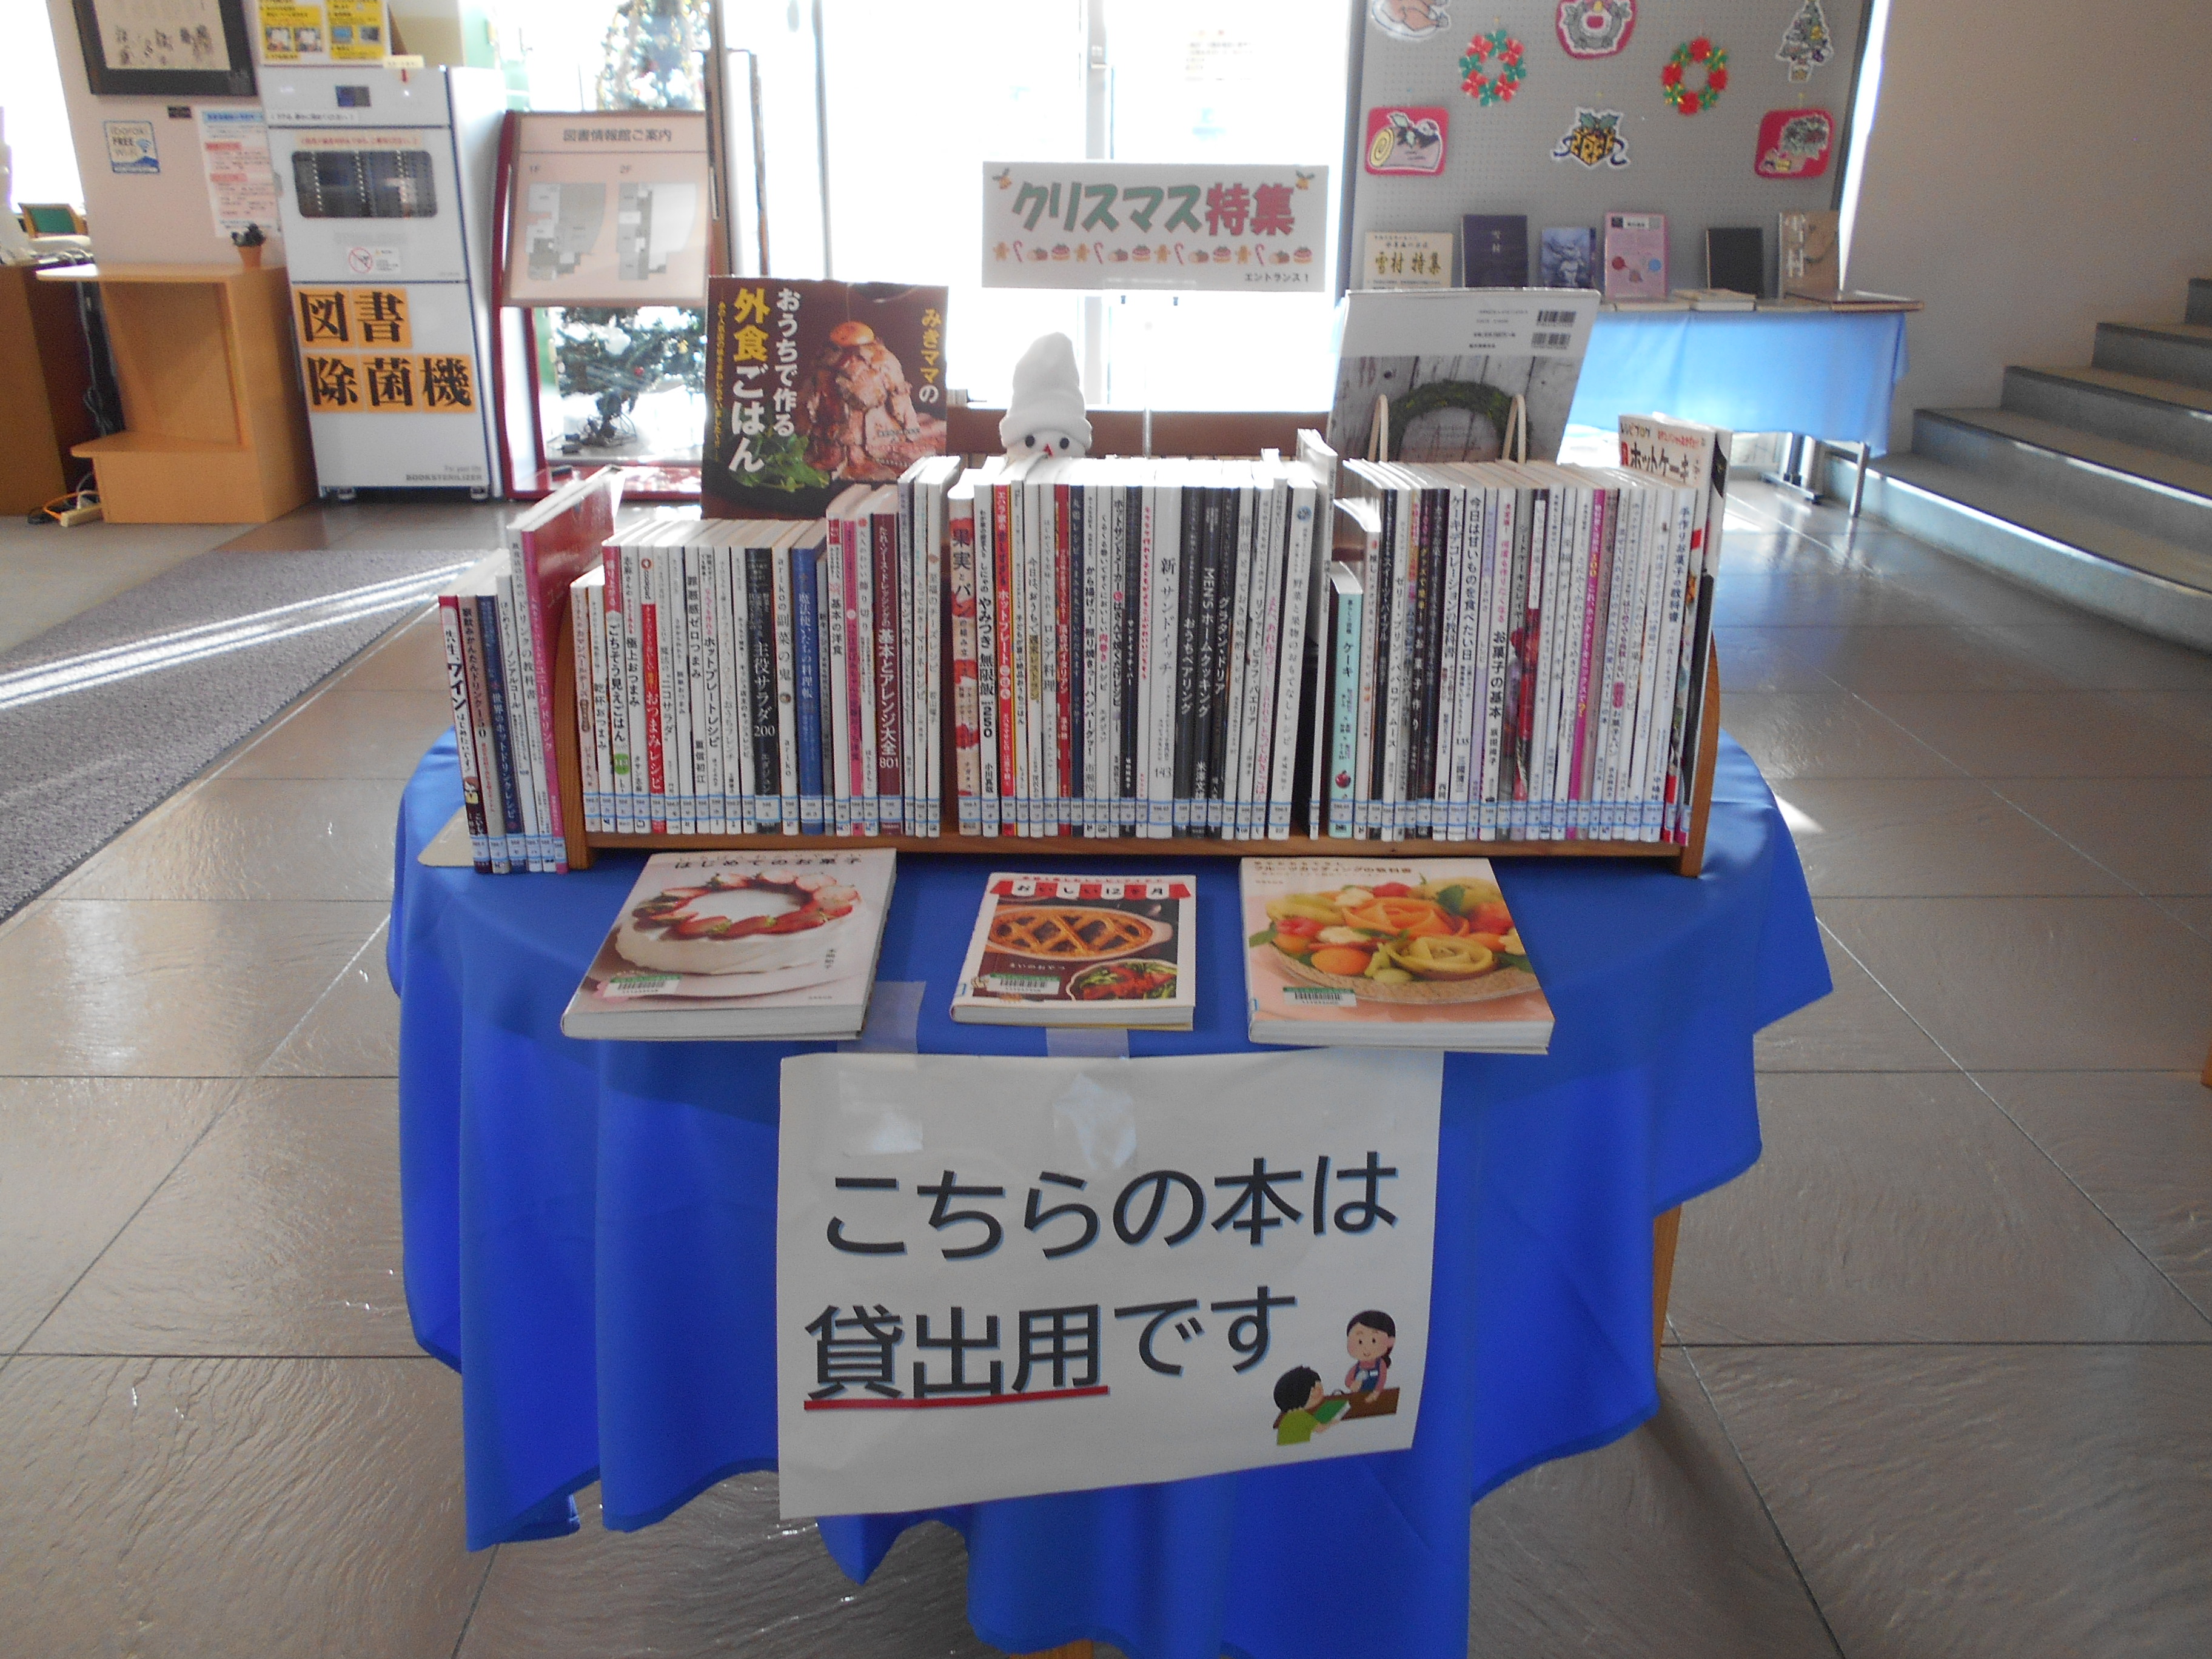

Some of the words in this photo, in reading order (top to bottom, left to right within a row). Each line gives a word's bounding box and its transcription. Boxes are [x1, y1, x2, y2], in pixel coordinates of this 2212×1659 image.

[112, 136, 134, 146] FREE
[563, 128, 672, 142] 図書情報館ご案内
[1011, 181, 1295, 237] クリスマス特集
[299, 290, 405, 344] 図書
[307, 355, 473, 408] 除菌機
[728, 287, 771, 473] 外食ごはん
[773, 287, 801, 437] おうちで作る
[919, 308, 942, 404] みきママの
[830, 597, 843, 655] 基本の洋食
[1044, 624, 1056, 692] ロシア料理
[1341, 642, 1354, 677] ケーキ
[1489, 632, 1506, 719] お菓子の基本
[878, 629, 897, 756] 基本とアレンジ大全
[646, 691, 663, 789] おつまみレシピ
[754, 725, 776, 737] 200
[879, 757, 899, 769] 801
[674, 856, 863, 870] はじめてのお菓子
[825, 1150, 1399, 1261] こちらの本は
[805, 1286, 1298, 1401] 貸出用です
